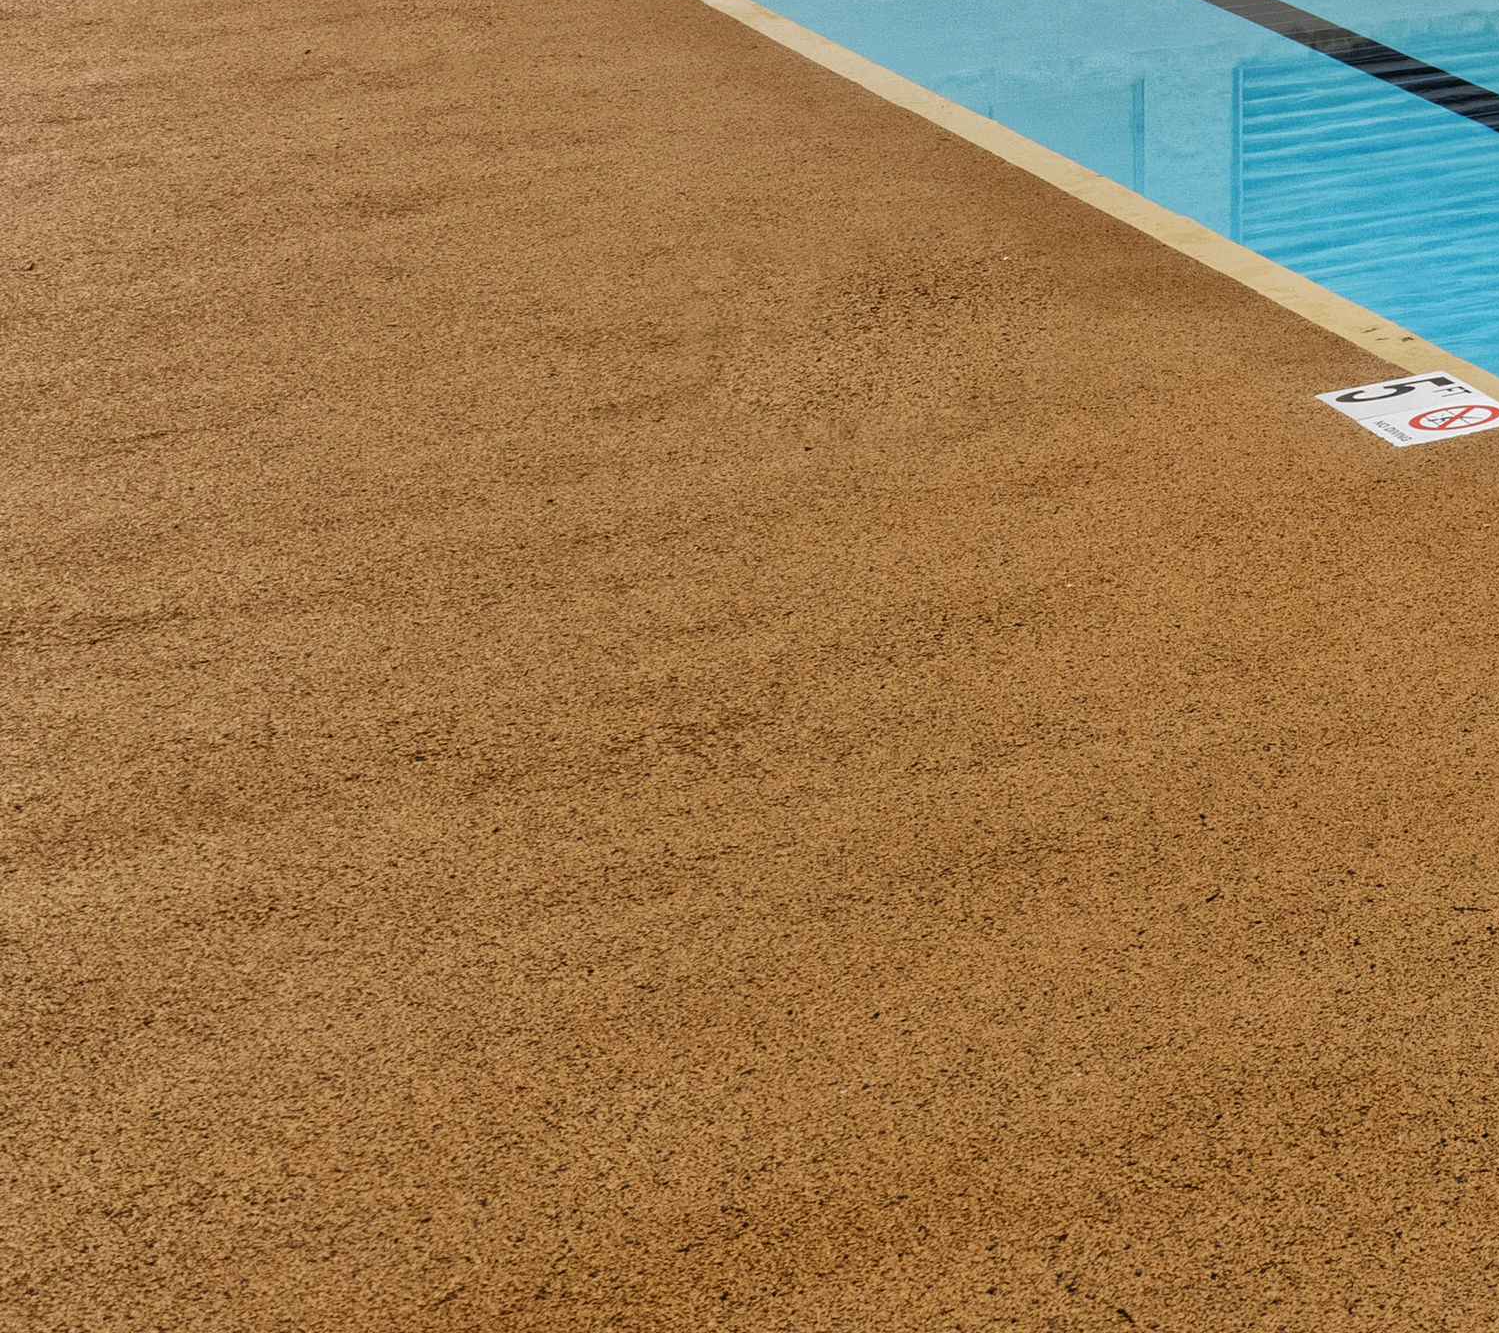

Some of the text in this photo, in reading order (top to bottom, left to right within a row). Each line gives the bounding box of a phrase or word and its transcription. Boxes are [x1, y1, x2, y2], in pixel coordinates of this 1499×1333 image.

[1335, 377, 1472, 402] 5 FT
[1385, 425, 1413, 442] DIVING
